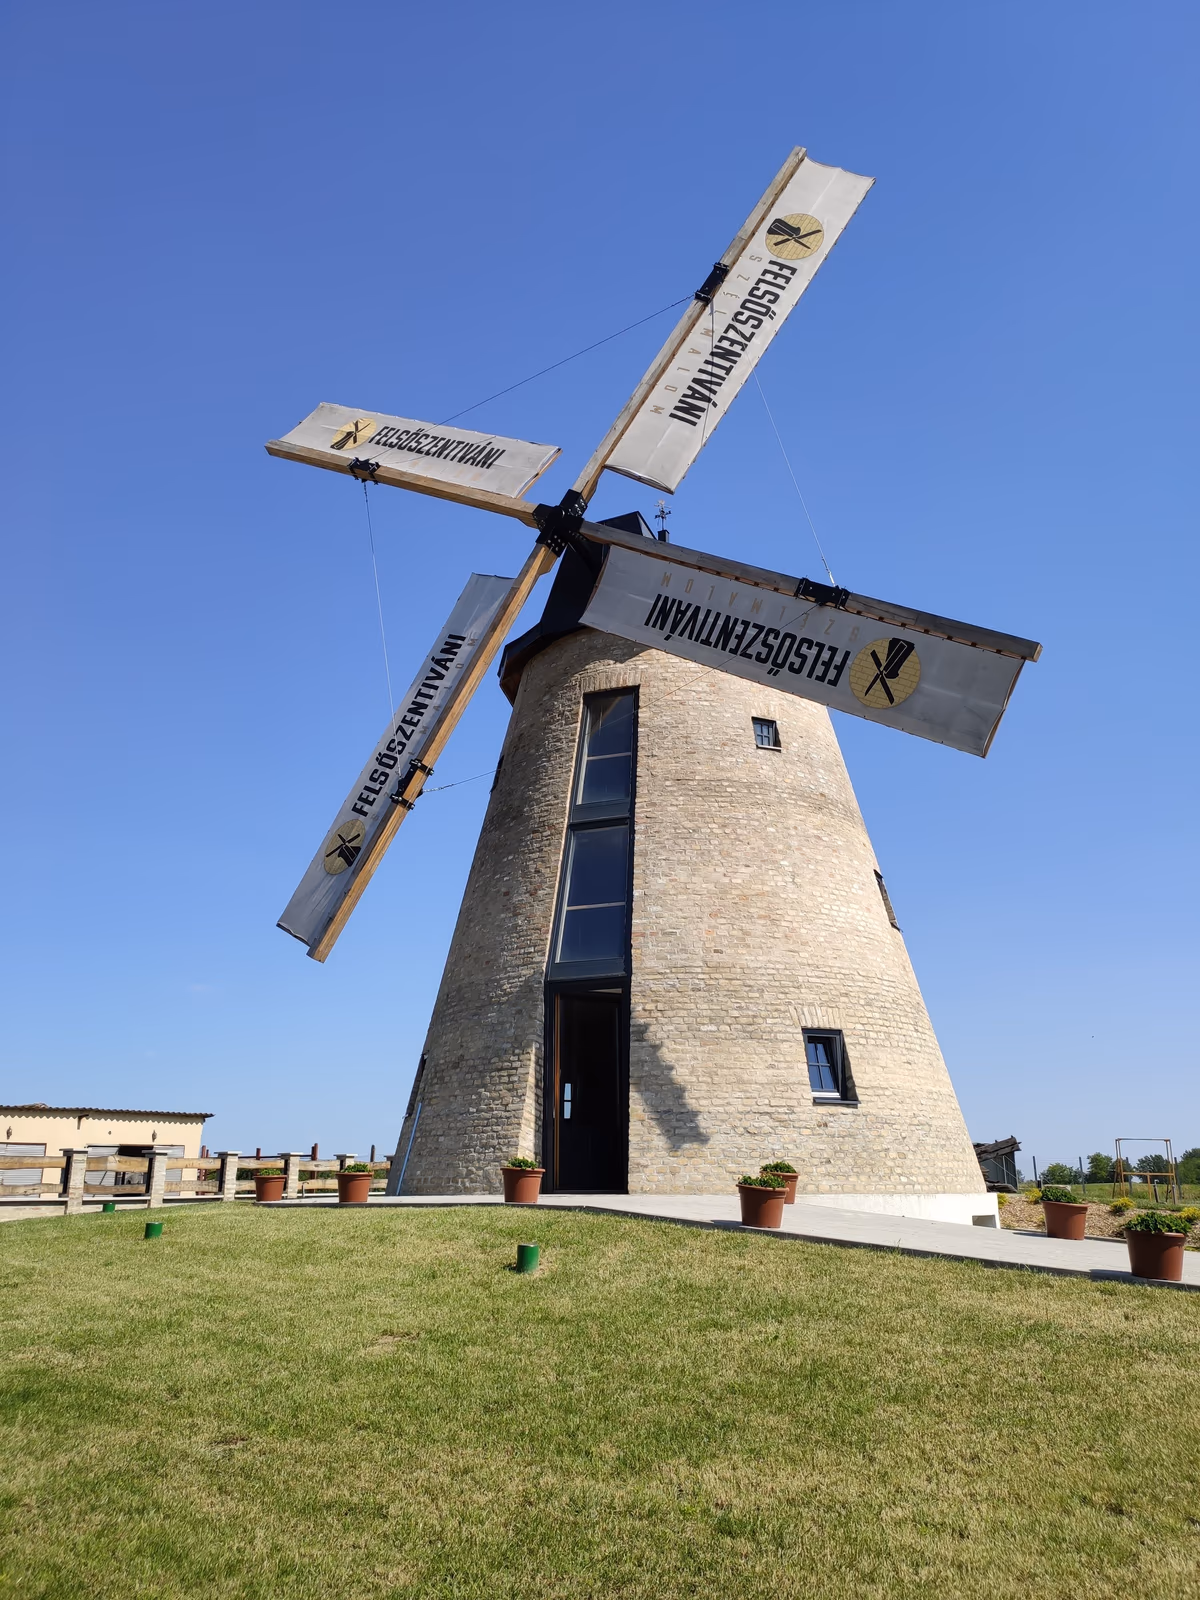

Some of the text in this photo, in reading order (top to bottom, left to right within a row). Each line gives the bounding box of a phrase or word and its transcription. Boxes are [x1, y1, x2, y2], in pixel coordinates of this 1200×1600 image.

[669, 260, 797, 427] FELSŐSZENTIVÁNI
[368, 426, 506, 469] FELSŐSZENTIVÁNI
[644, 593, 851, 687] FELSŐSZENTIVÁNI
[352, 633, 466, 817] FELSŐSZENTIVÁNI
